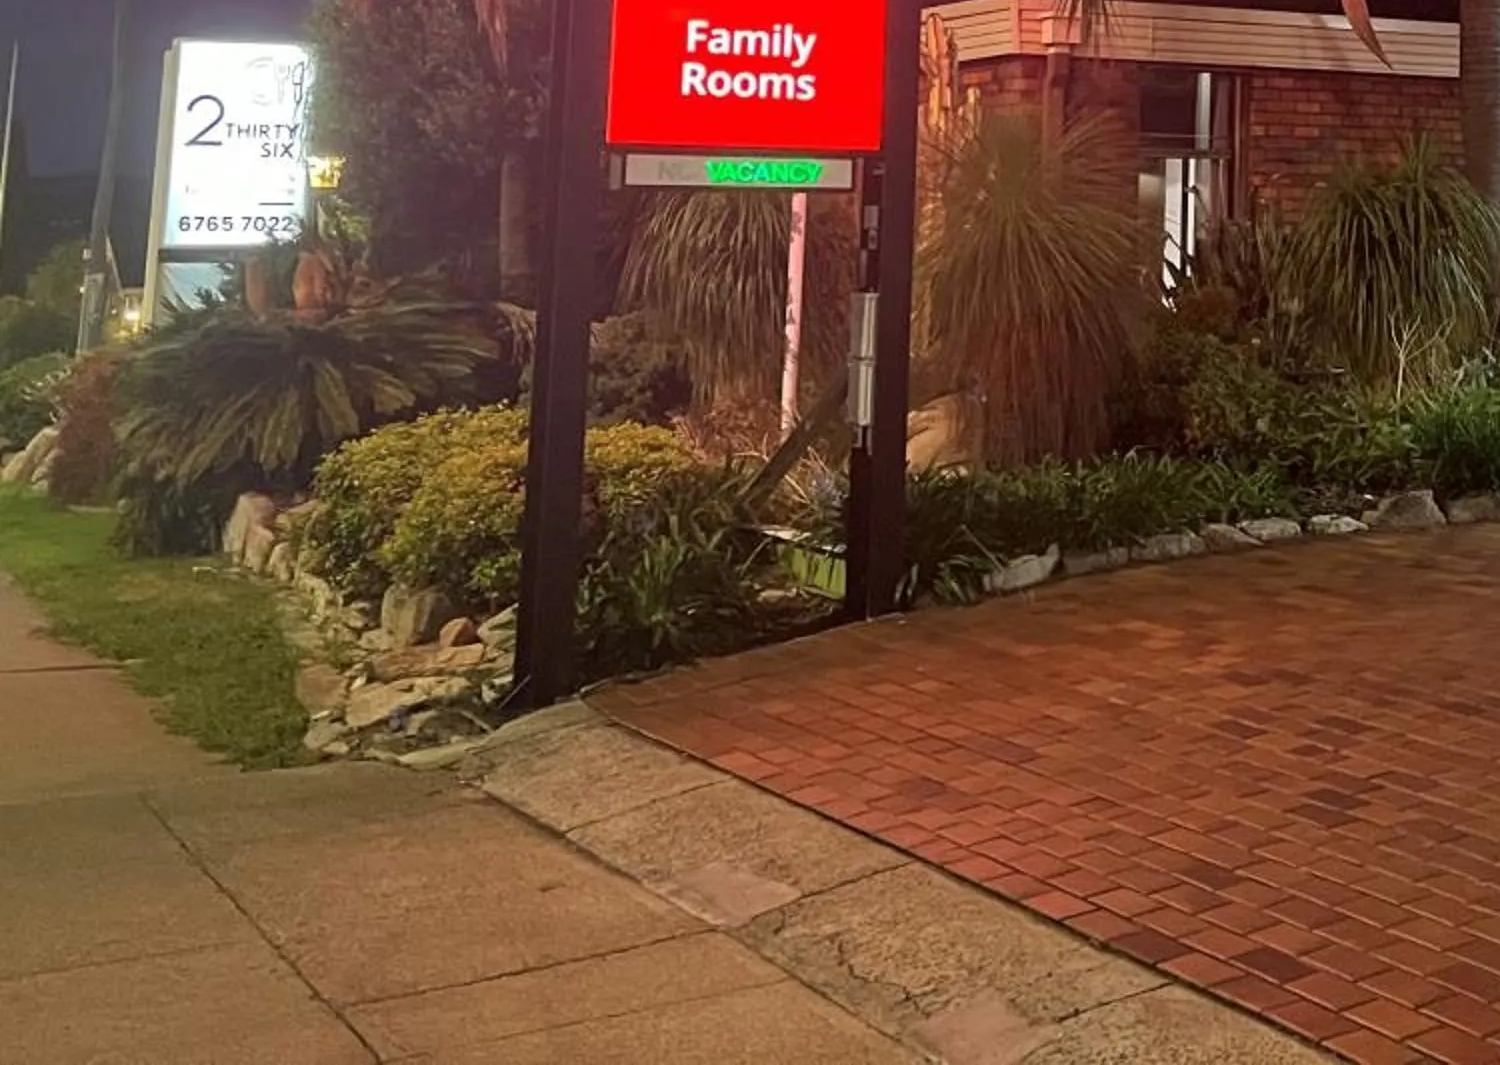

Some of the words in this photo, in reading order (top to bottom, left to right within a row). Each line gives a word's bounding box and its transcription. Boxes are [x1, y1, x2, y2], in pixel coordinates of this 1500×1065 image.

[686, 20, 816, 66] Family
[680, 62, 816, 102] Rooms
[185, 94, 225, 146] 2
[226, 123, 299, 139] THIRTY
[260, 142, 294, 158] SIX
[705, 158, 823, 184] VACANCY
[179, 216, 233, 232] 6765
[241, 216, 293, 233] 7022
